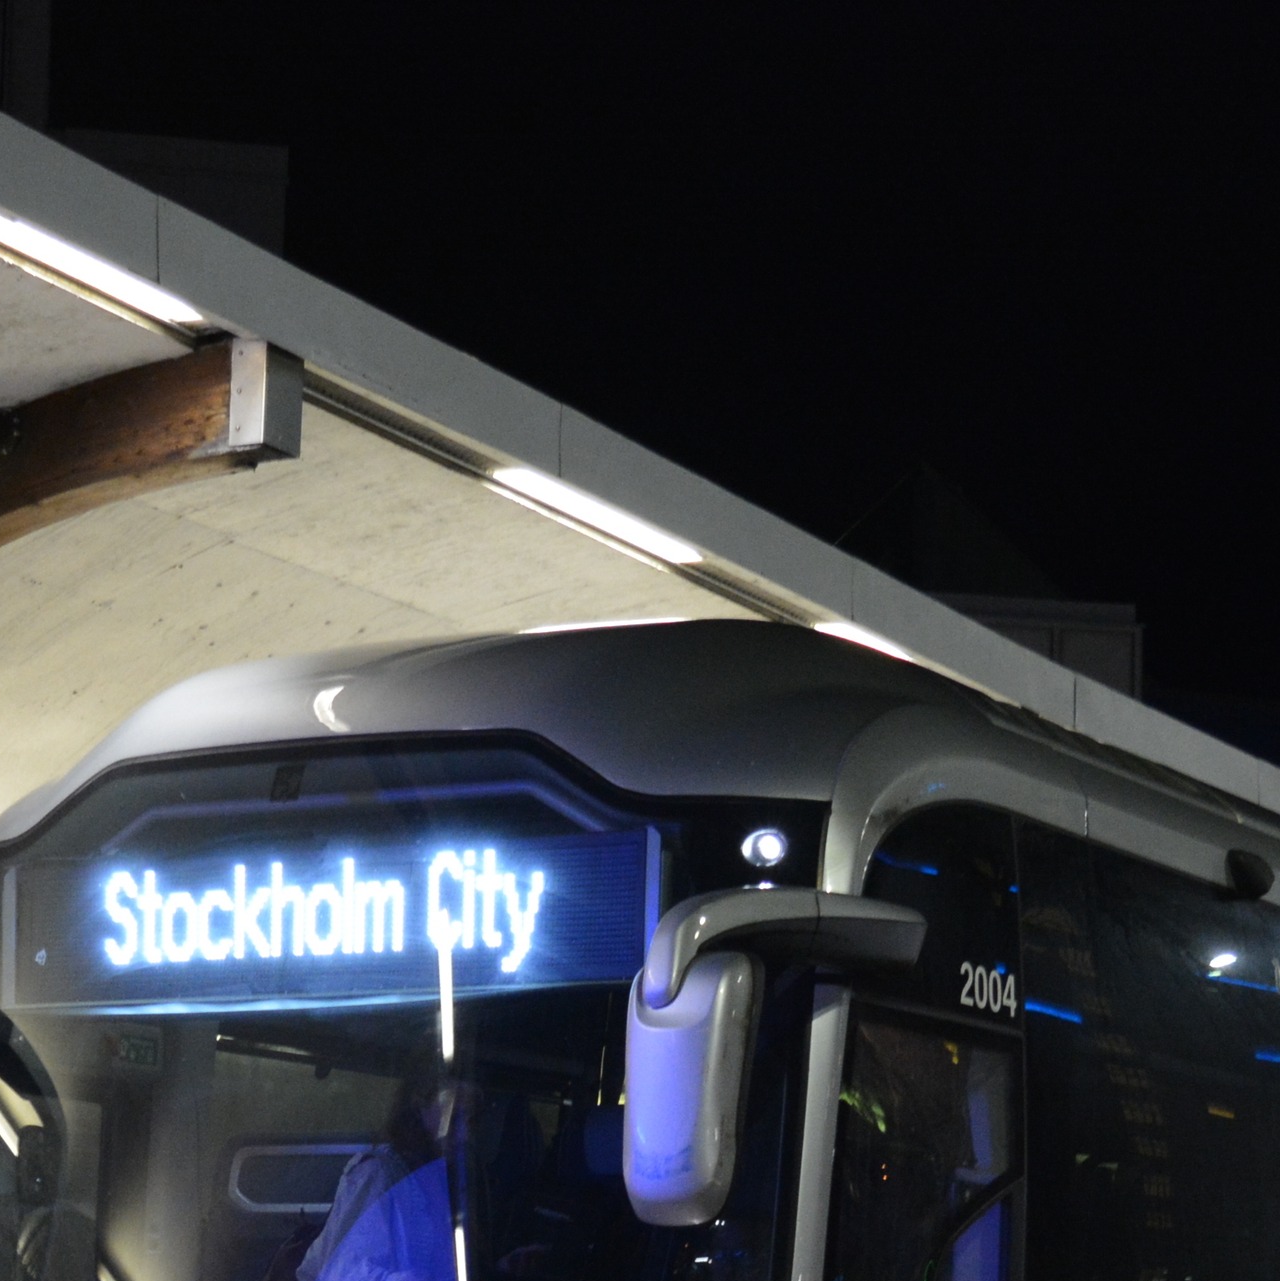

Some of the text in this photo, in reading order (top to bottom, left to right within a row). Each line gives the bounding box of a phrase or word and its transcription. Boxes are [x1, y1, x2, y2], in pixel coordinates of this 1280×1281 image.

[103, 848, 545, 973] Stockholm City
[960, 960, 1018, 1018] 2004
